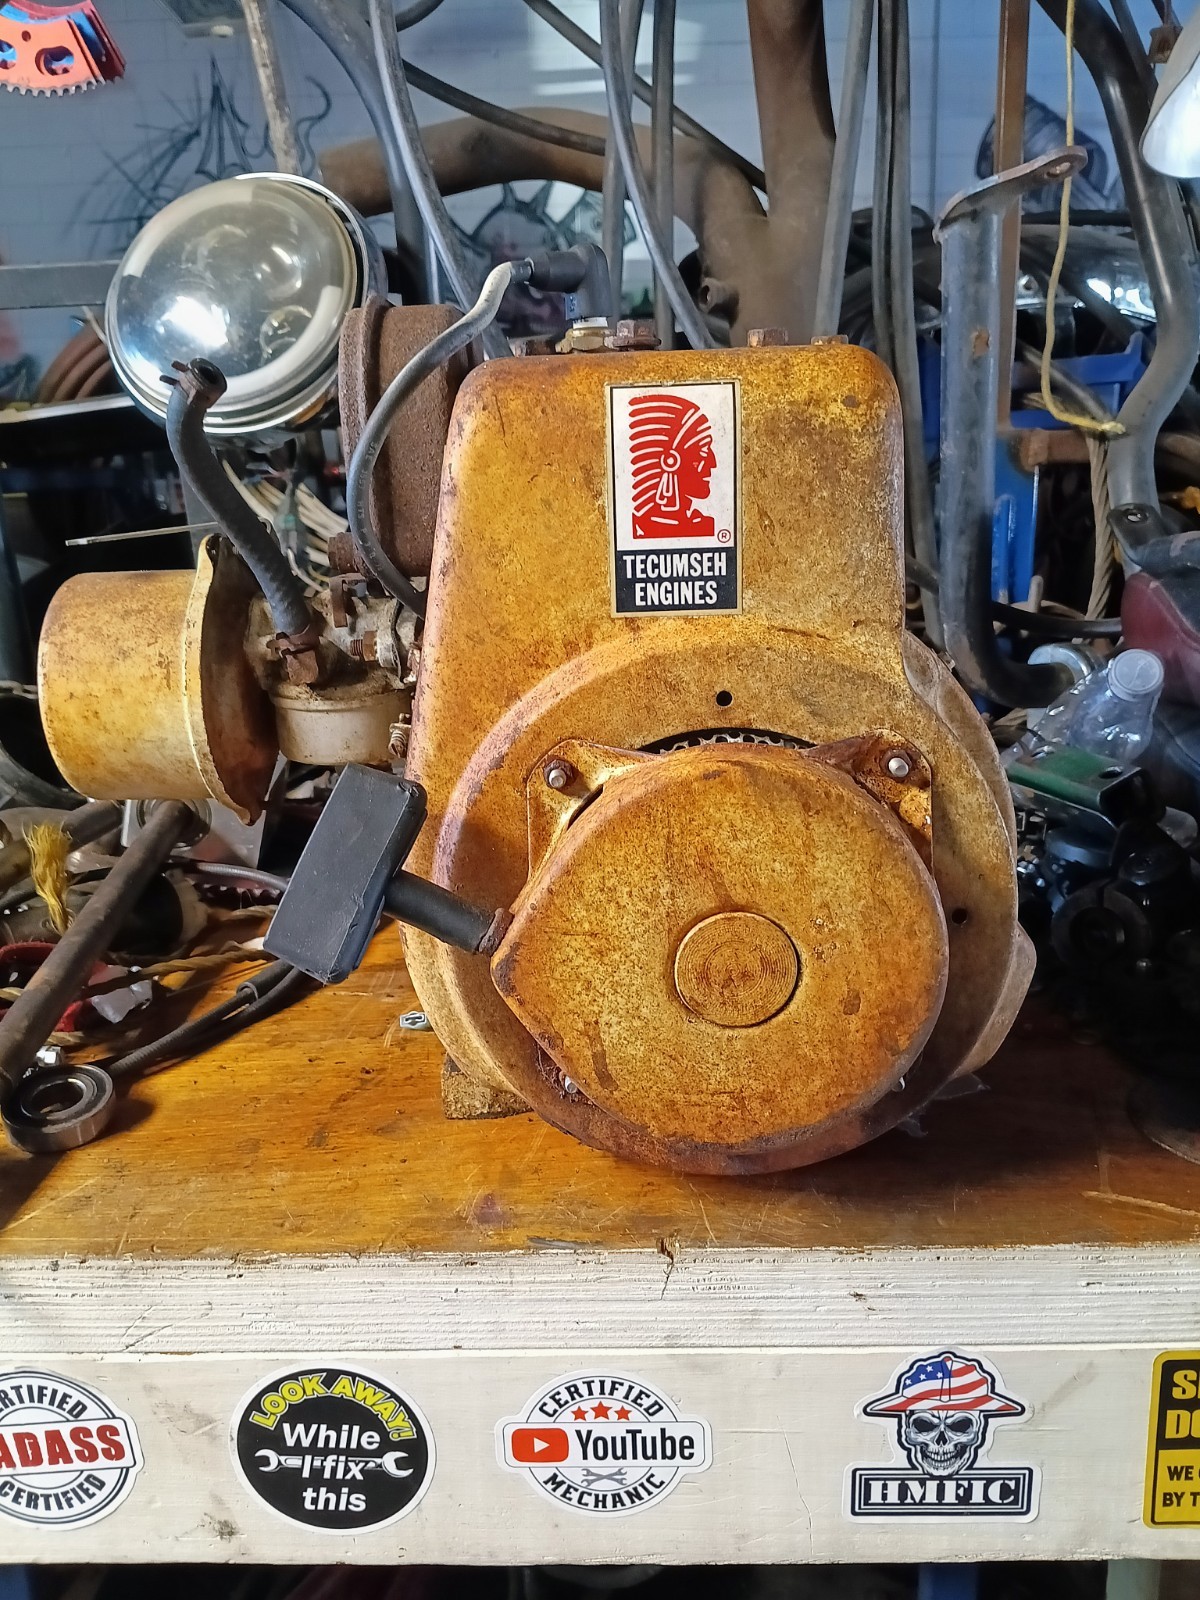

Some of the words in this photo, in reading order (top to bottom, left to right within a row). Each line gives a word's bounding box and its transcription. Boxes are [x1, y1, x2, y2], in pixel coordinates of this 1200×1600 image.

[623, 552, 727, 579] TECUMSEH
[635, 581, 718, 606] ENGINES
[1172, 1369, 1200, 1400] S
[0, 1384, 88, 1419] RTIFIED
[250, 1373, 329, 1429] LOOK
[330, 1375, 417, 1441] AWAY!
[538, 1379, 665, 1418] CERTIFIED
[283, 1423, 381, 1450] While
[575, 1427, 695, 1461] YouTube
[302, 1454, 312, 1478] I
[323, 1454, 366, 1480] fix
[1167, 1466, 1194, 1481] WE
[0, 1473, 107, 1511] CERTIFIED
[302, 1487, 367, 1511] this
[543, 1472, 665, 1509] MECHANIC
[869, 1479, 1016, 1504] HMFIC
[1162, 1492, 1185, 1507] BY
